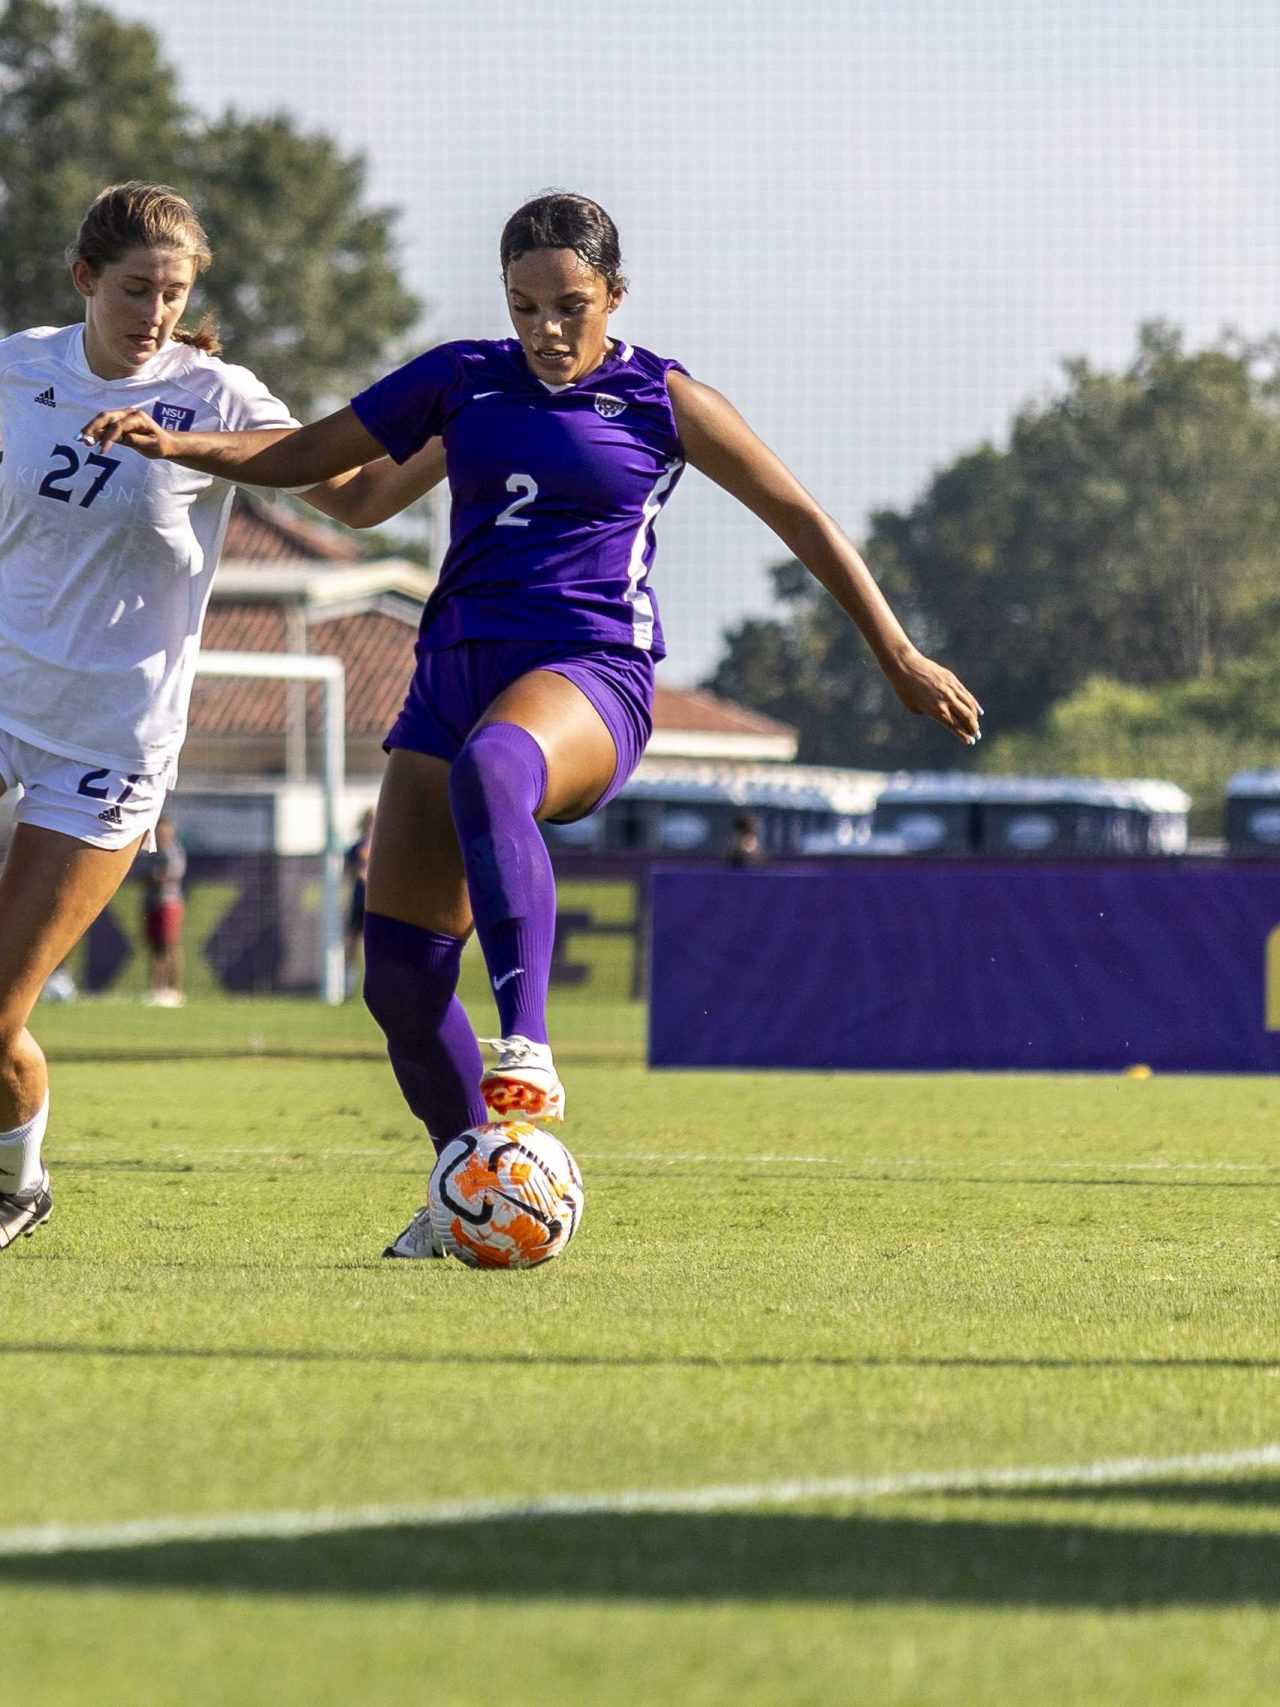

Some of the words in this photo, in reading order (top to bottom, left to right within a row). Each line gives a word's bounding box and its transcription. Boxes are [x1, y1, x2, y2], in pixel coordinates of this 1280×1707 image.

[161, 406, 186, 419] NSU
[37, 443, 122, 510] 27
[495, 472, 539, 527] 2
